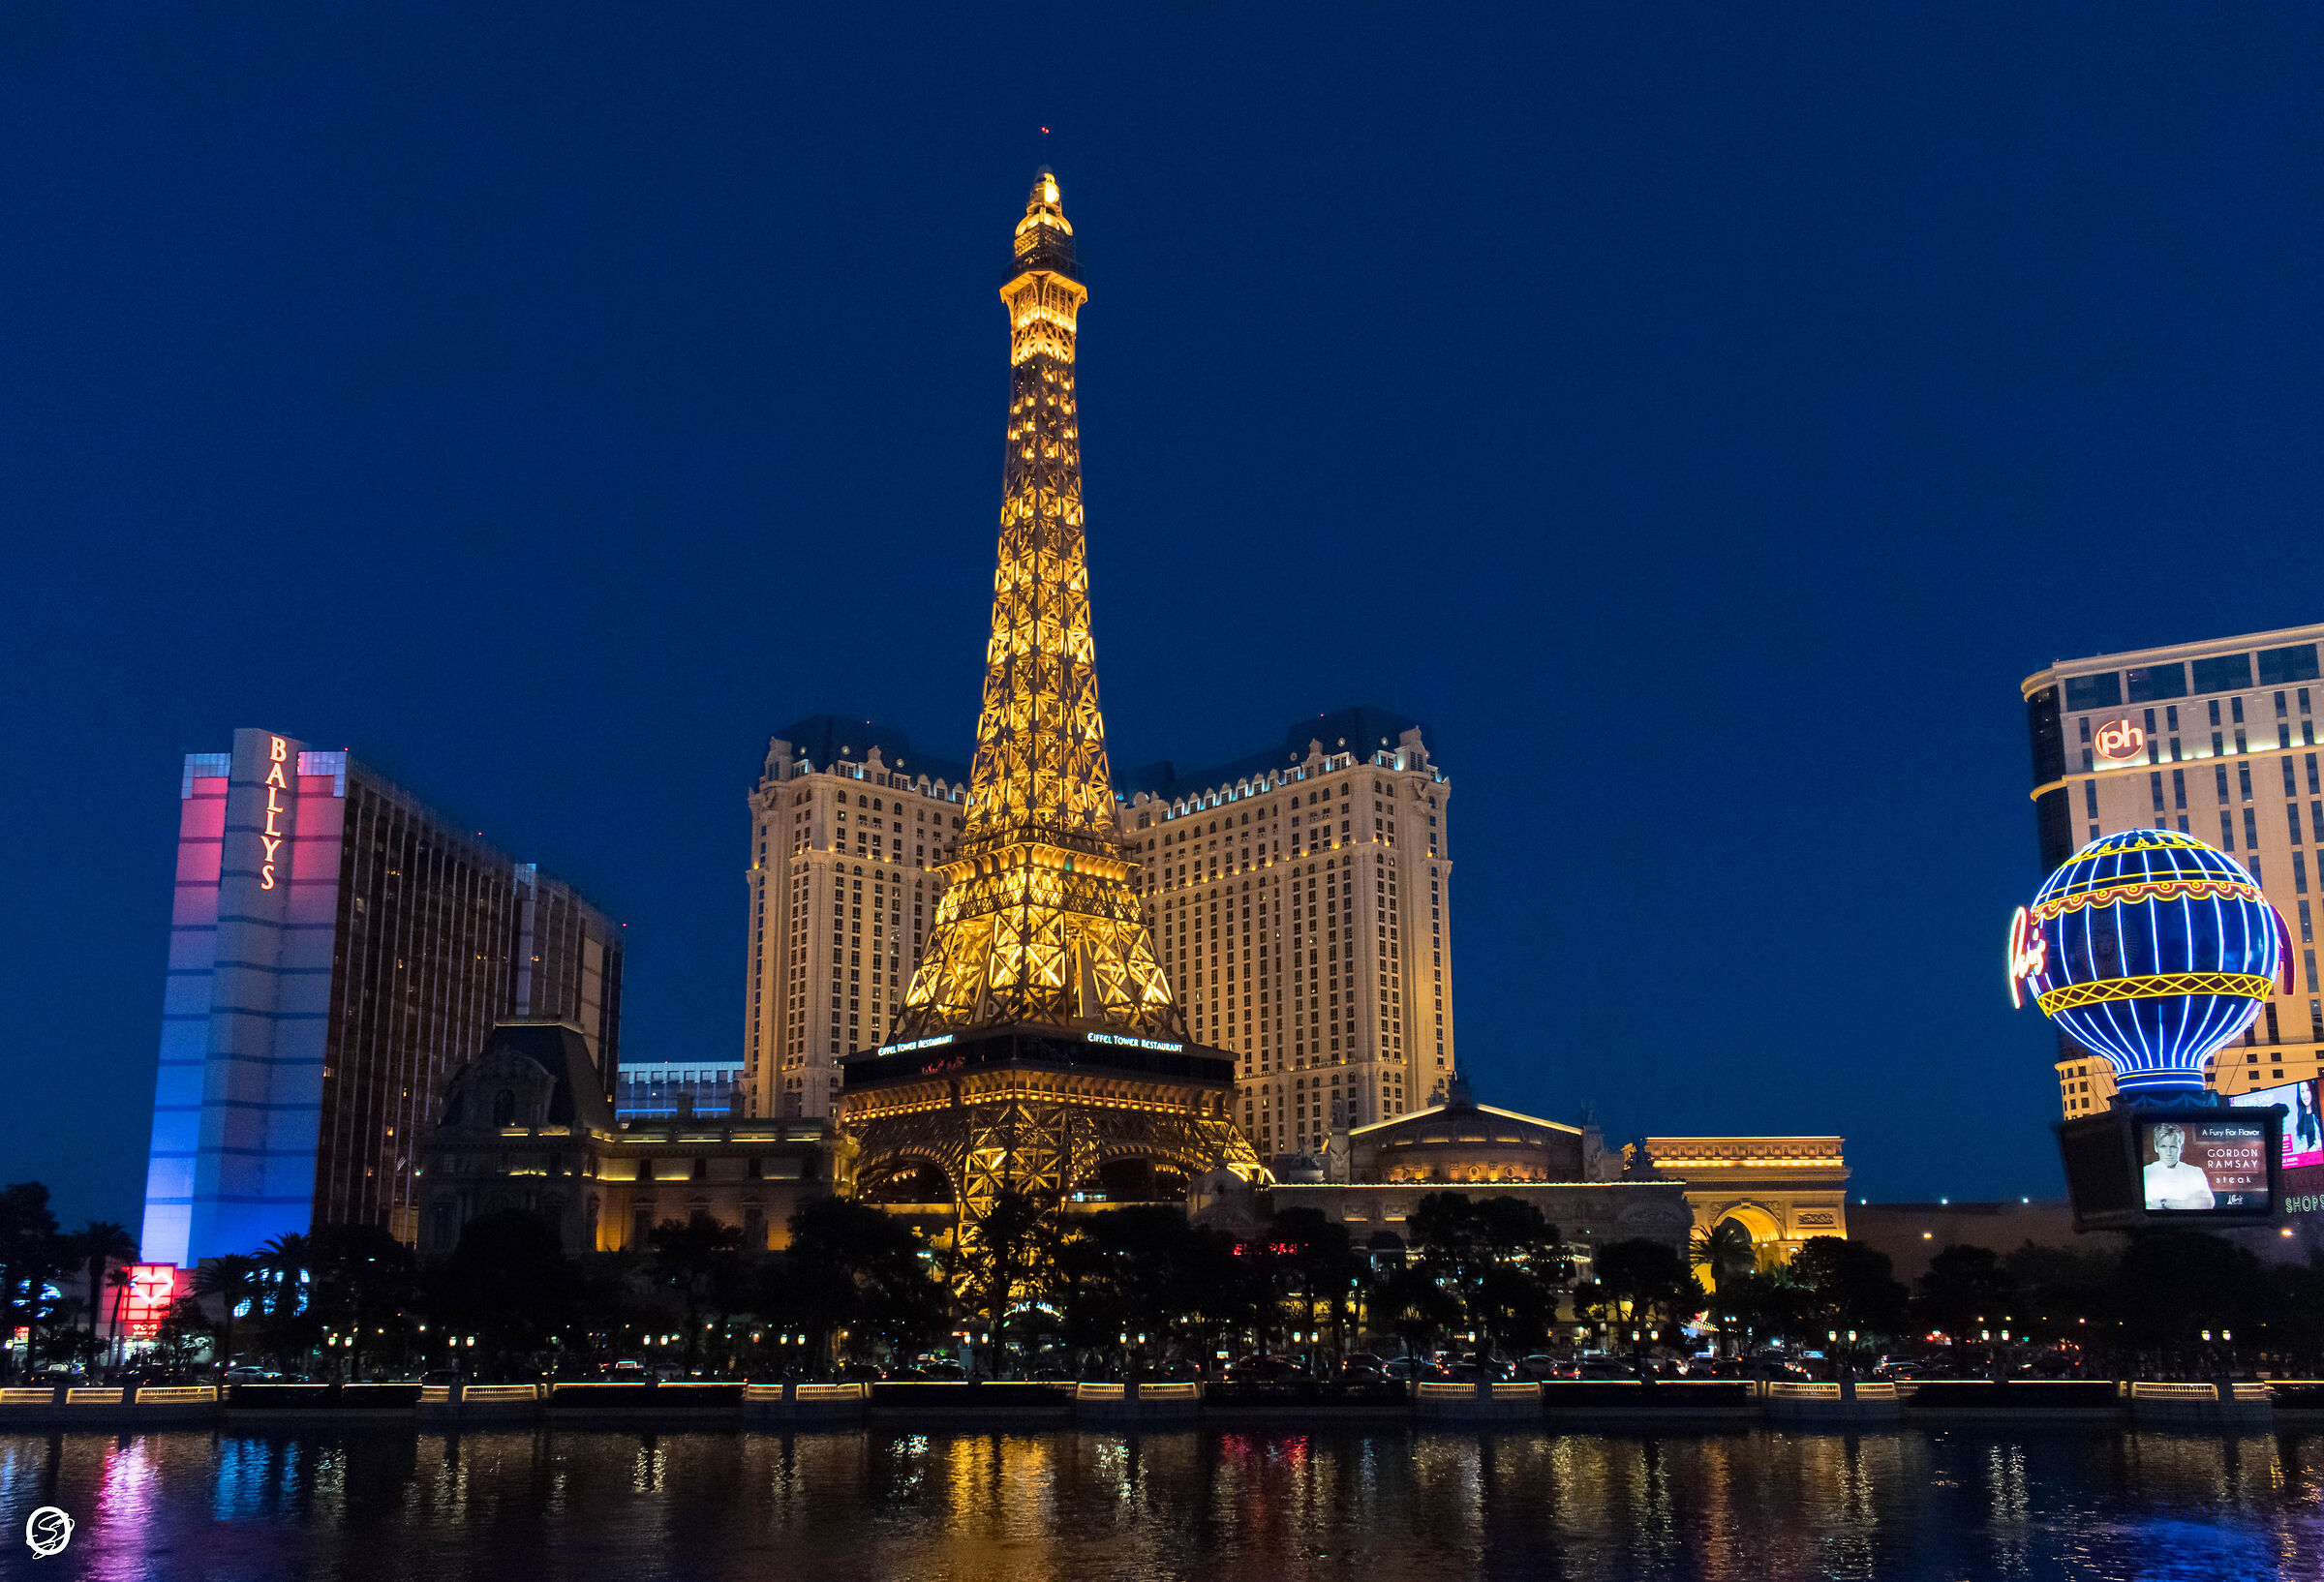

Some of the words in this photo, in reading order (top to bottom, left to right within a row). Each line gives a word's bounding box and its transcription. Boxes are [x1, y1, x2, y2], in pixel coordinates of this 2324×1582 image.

[2100, 719, 2144, 756] ph
[877, 1046, 898, 1056] EIFFEL
[897, 1041, 917, 1052] TOWER
[918, 1034, 954, 1049] RESTAURANT
[1087, 1032, 1113, 1044] EIFFEL
[1113, 1035, 1139, 1047] TOWER
[1141, 1039, 1183, 1052] RESTAURANT
[2209, 1128, 2224, 1138] Fury
[2238, 1128, 2261, 1137] Flavor
[2207, 1148, 2258, 1158] GORDON
[2207, 1160, 2258, 1169] RAMSAY
[2216, 1175, 2252, 1184] steak
